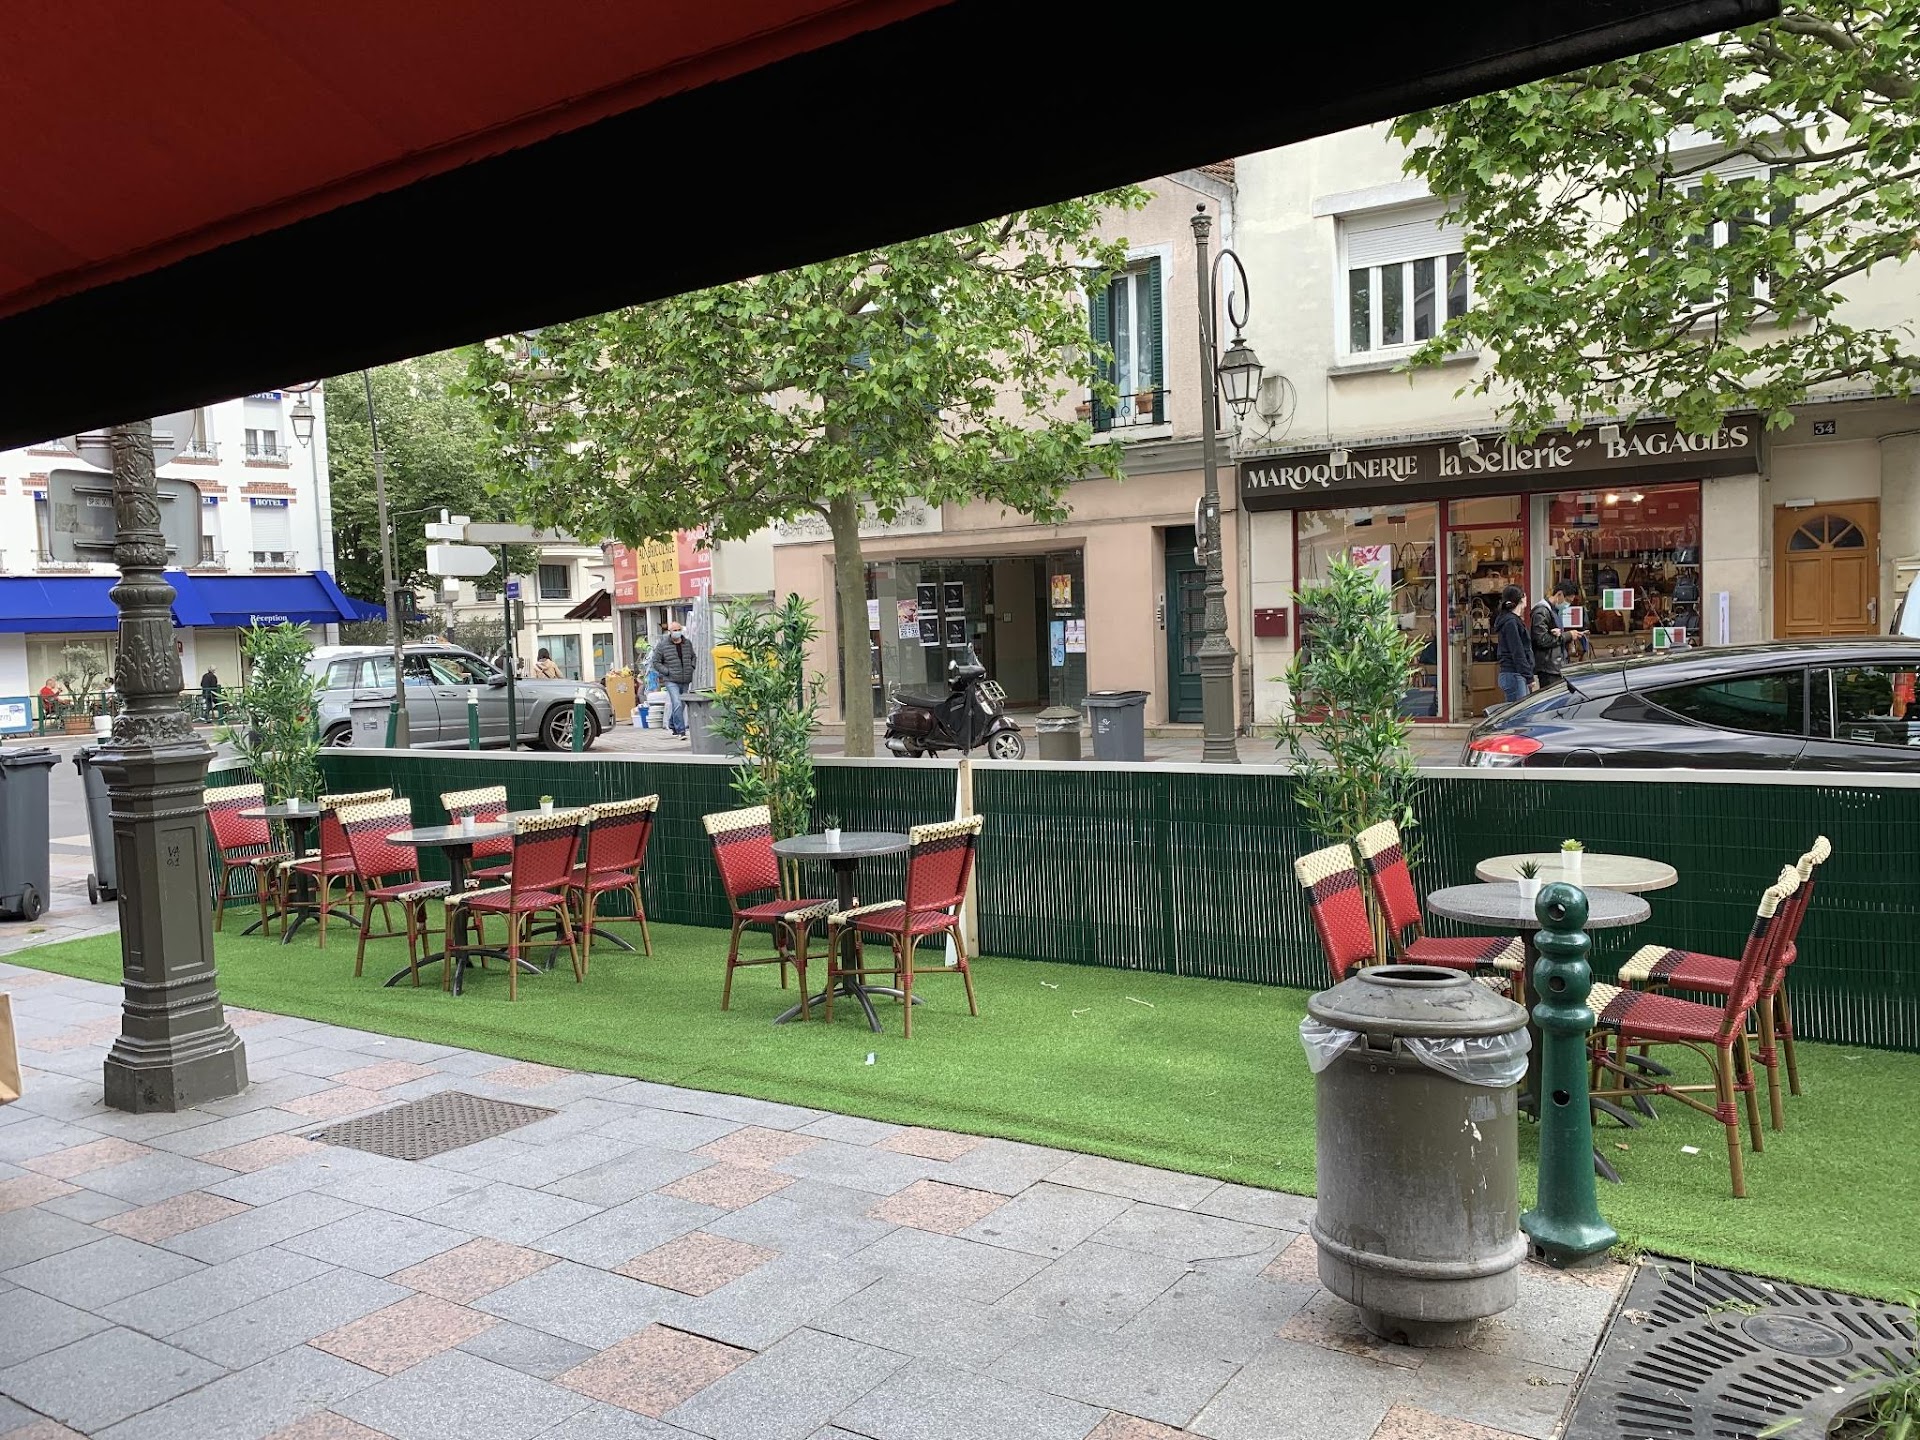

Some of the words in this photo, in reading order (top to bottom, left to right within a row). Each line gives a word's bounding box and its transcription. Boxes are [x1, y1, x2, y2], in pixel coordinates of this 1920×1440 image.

[1815, 421, 1835, 435] 34
[1248, 455, 1418, 490] MAROQUINERIE
[1439, 448, 1463, 477] la
[1607, 425, 1749, 459] BAGAGES
[250, 614, 288, 624] Réception
